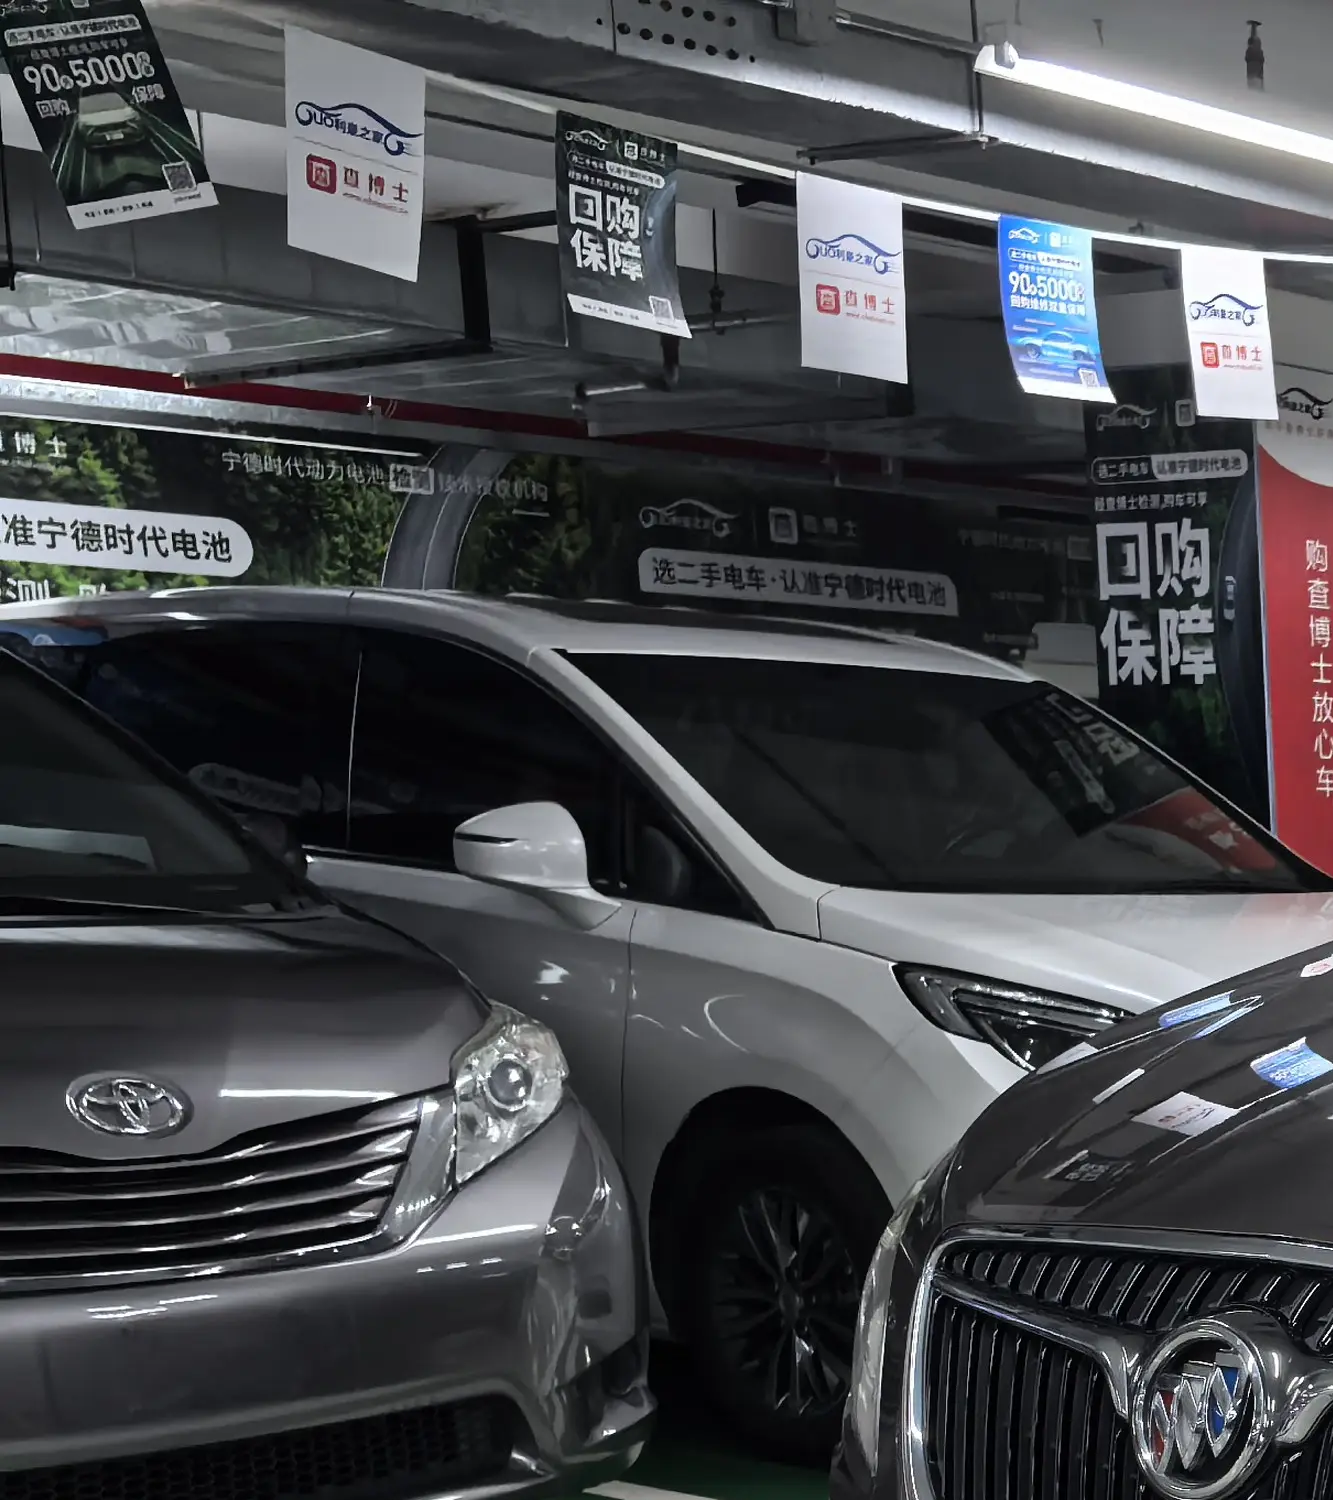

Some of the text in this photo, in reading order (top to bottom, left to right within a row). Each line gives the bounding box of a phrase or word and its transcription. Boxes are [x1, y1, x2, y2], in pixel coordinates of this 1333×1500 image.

[569, 184, 640, 240] 回购
[570, 228, 643, 281] 保障
[0, 431, 67, 459] 博士
[0, 513, 232, 564] 准宁德时代电池
[1096, 517, 1210, 600] 回购
[1100, 603, 1217, 686] 保障
